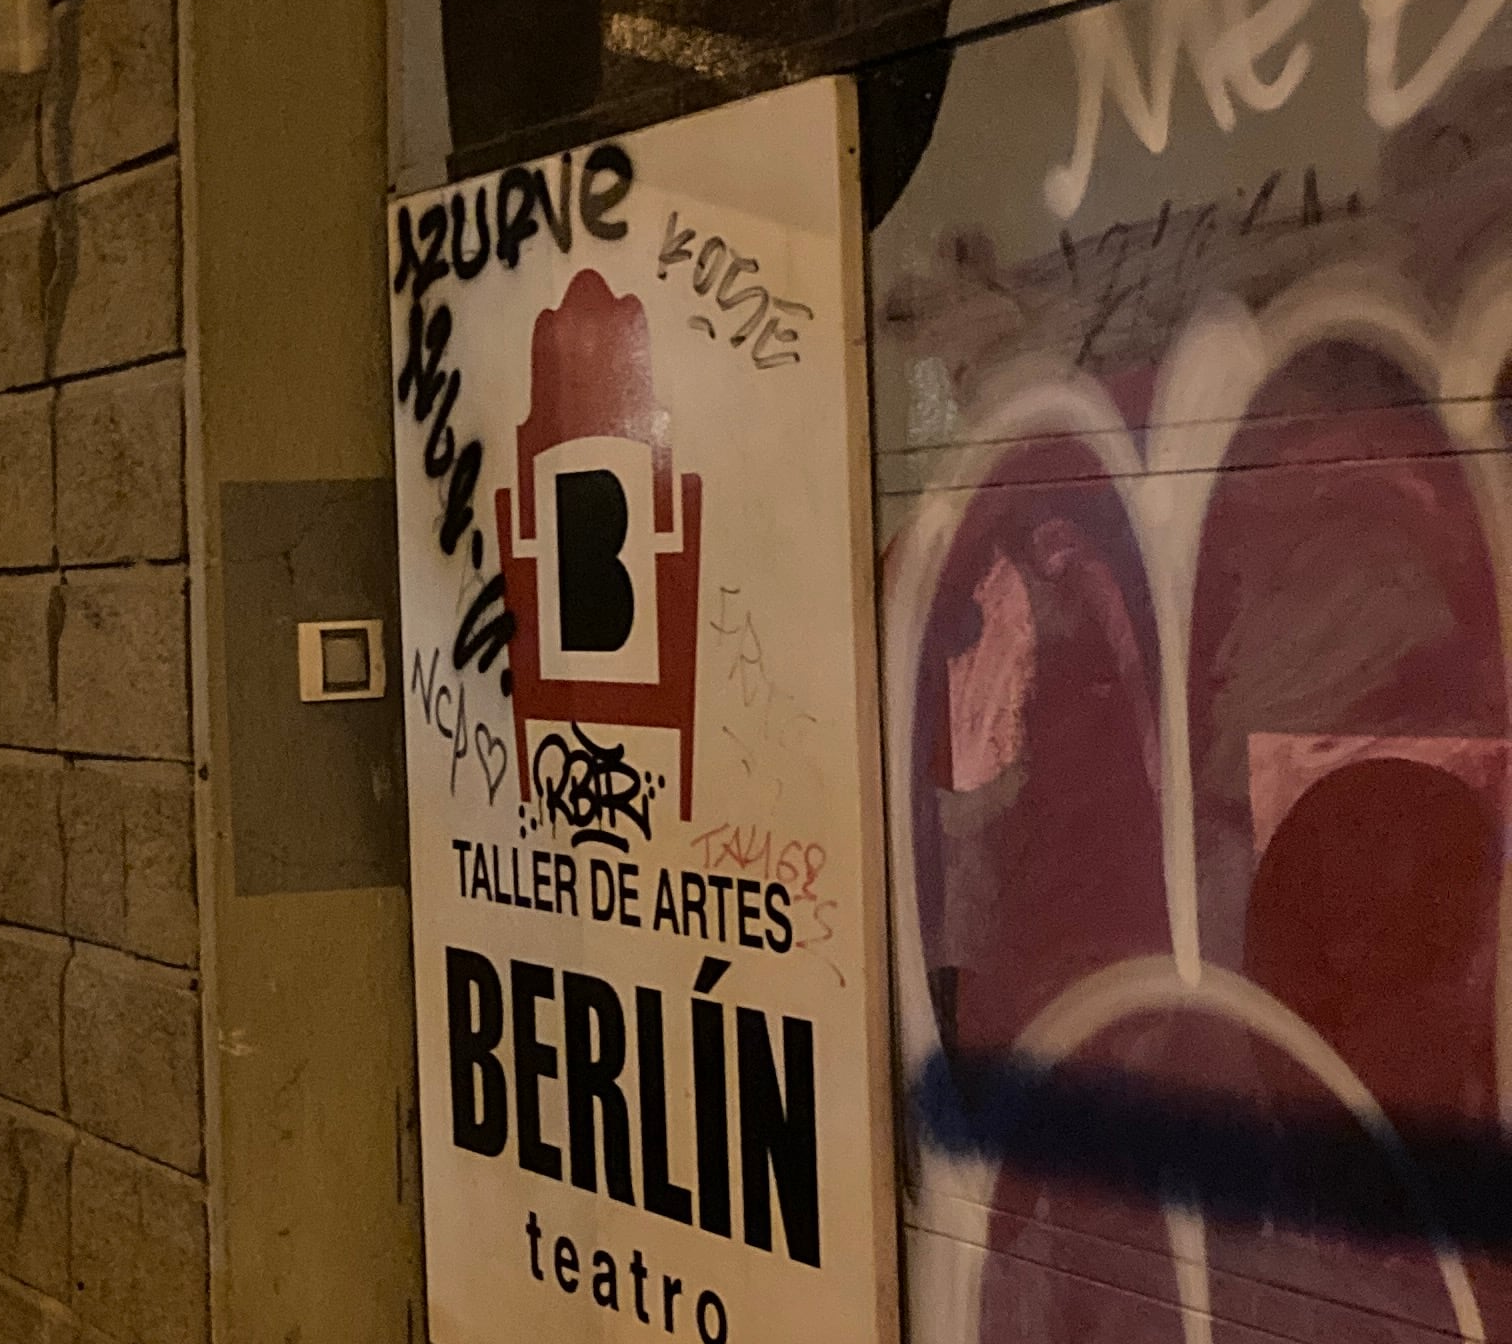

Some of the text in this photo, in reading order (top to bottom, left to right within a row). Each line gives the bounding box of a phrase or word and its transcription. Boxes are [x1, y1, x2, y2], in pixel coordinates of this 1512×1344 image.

[554, 468, 635, 653] B
[452, 838, 794, 955] TALLER DE ARTES
[444, 945, 823, 1270] BERLÍN
